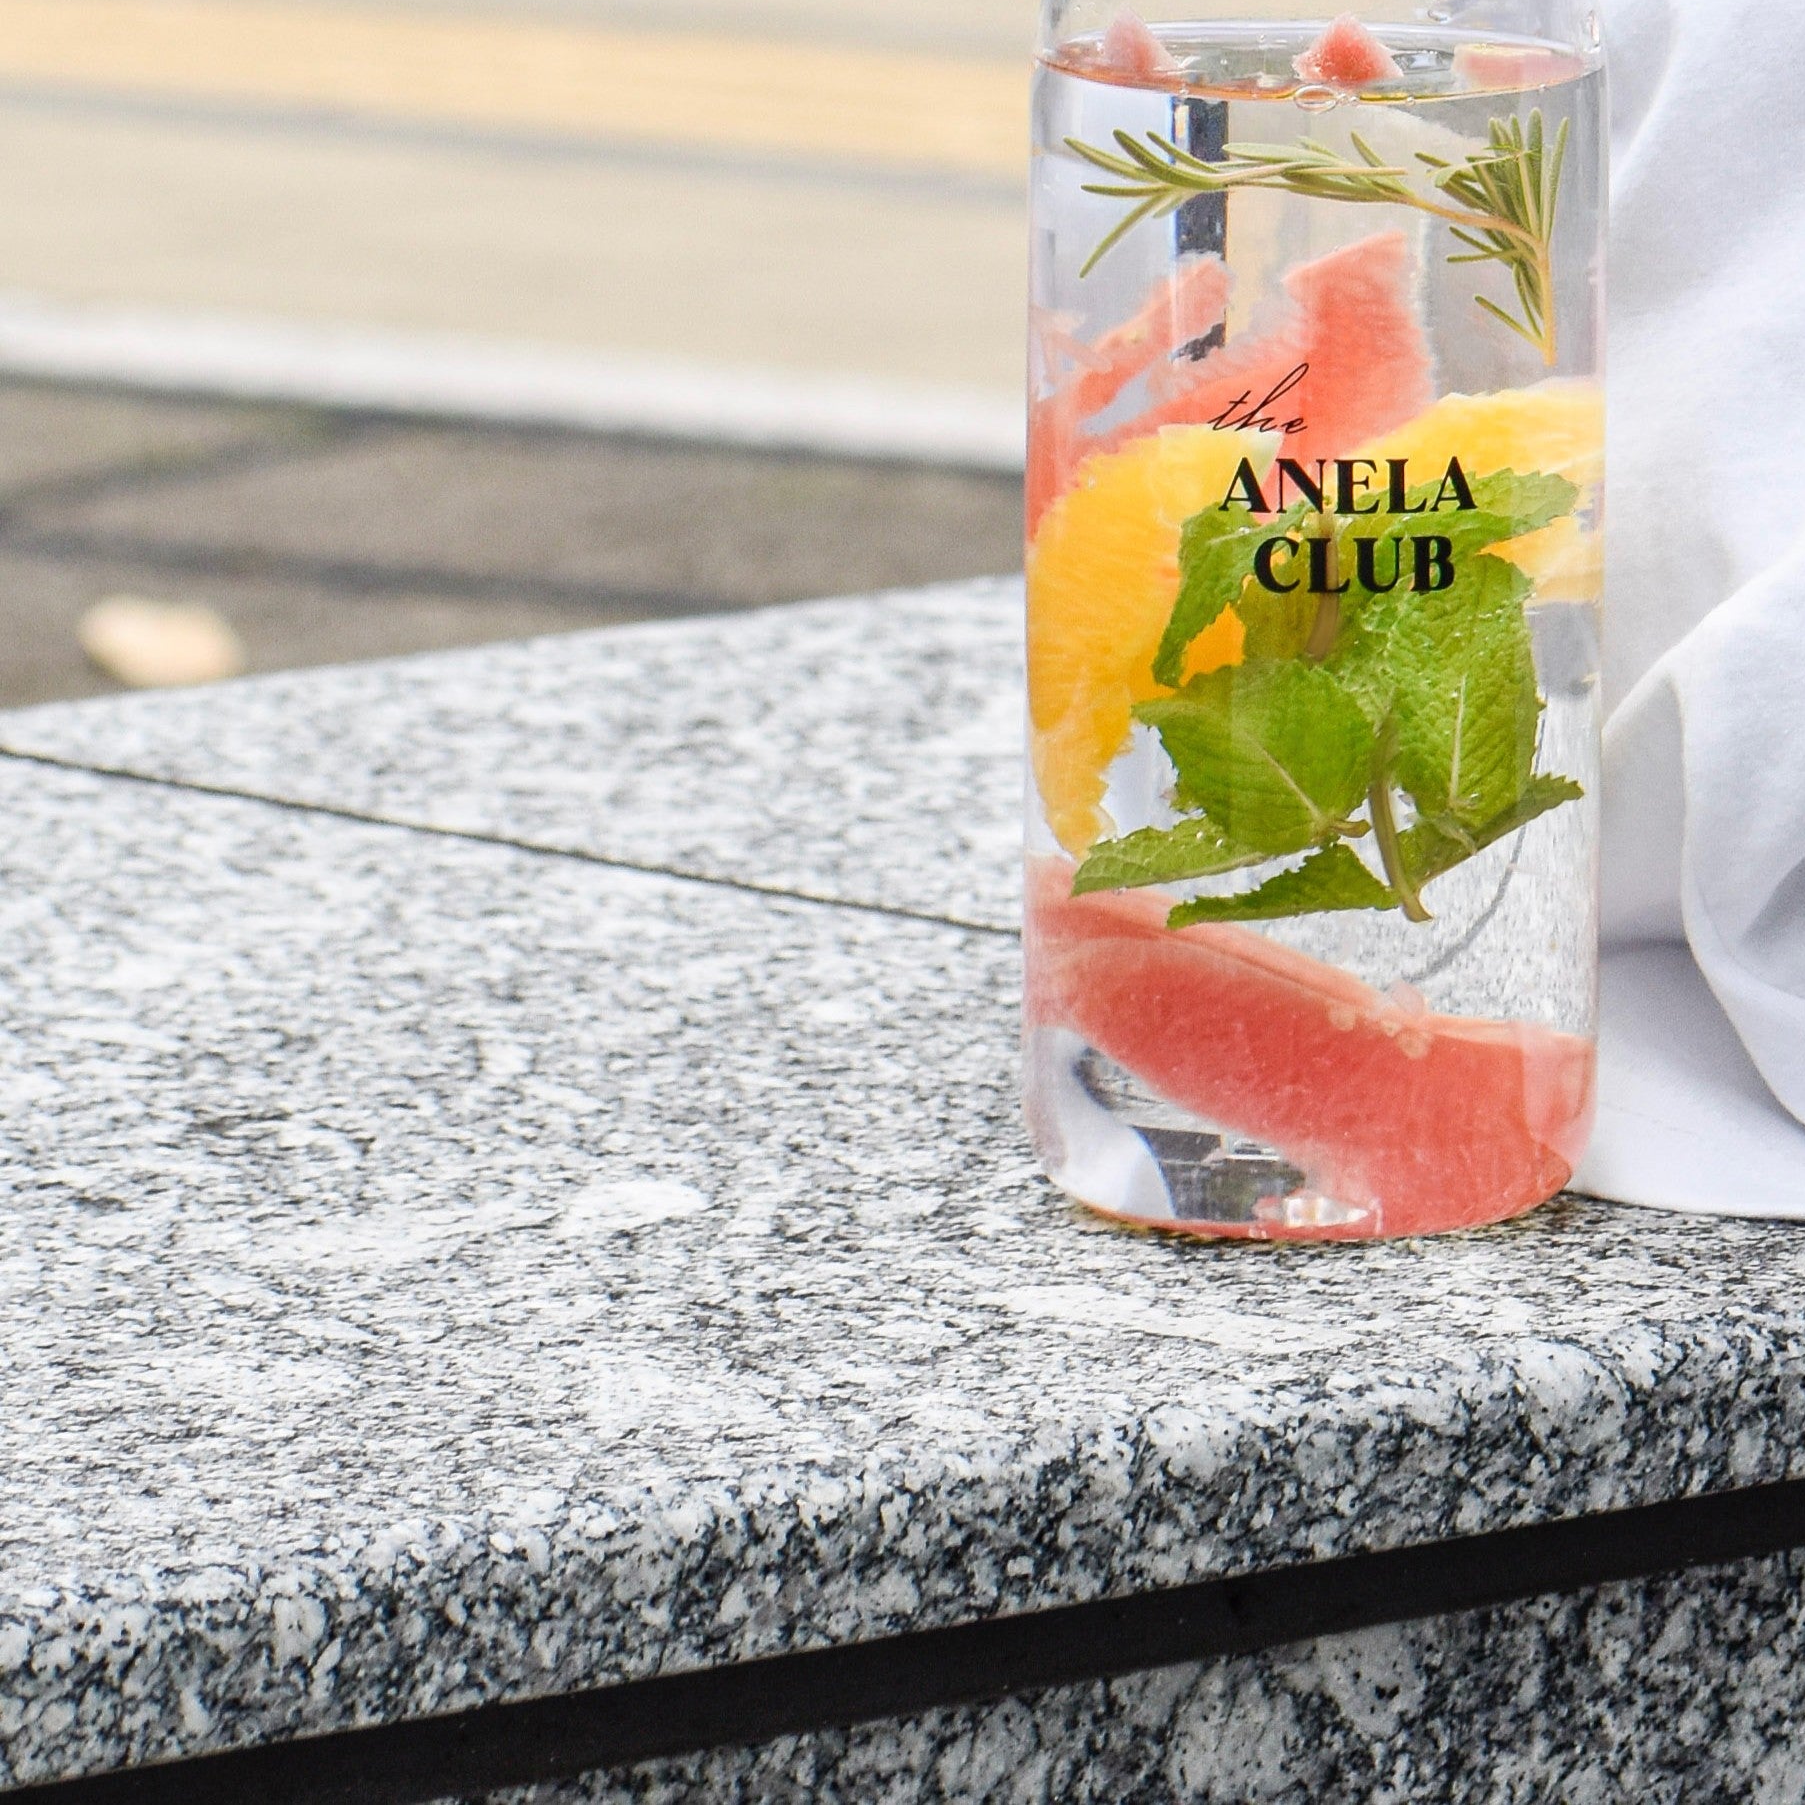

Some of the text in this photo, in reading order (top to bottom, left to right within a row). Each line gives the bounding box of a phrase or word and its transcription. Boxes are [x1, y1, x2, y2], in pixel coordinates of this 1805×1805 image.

[1209, 362, 1309, 434] the
[1219, 456, 1478, 514] ANELA
[1253, 535, 1455, 595] CLUB
